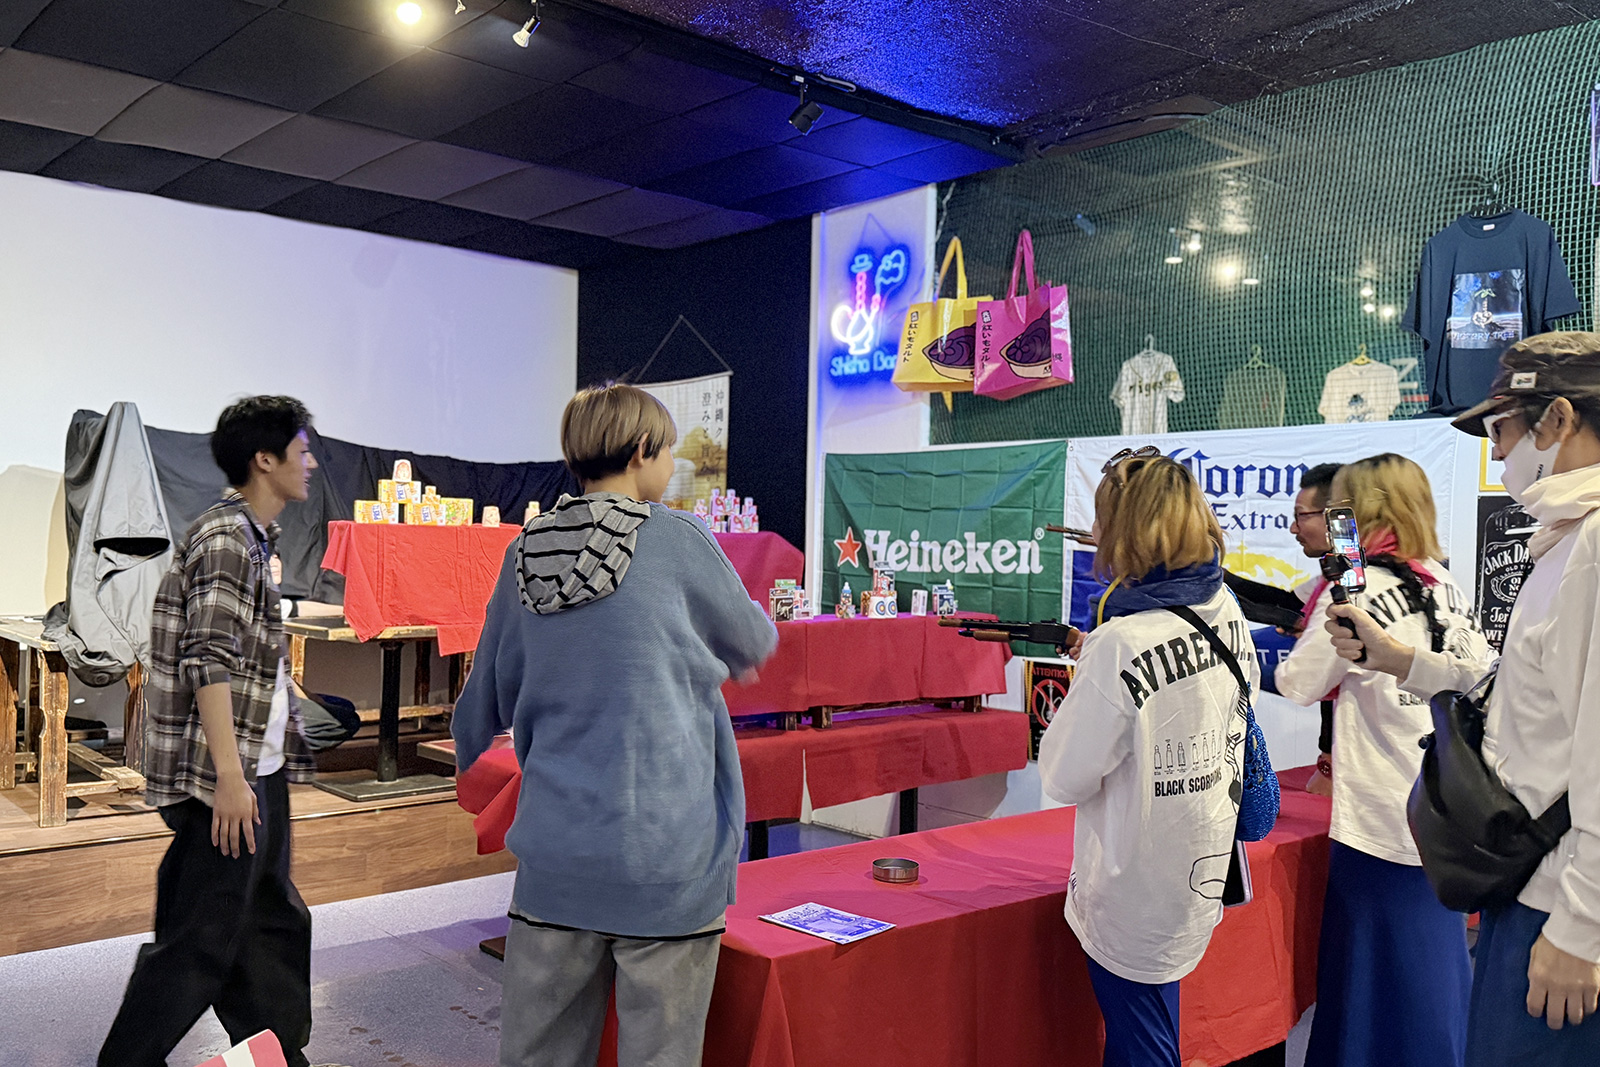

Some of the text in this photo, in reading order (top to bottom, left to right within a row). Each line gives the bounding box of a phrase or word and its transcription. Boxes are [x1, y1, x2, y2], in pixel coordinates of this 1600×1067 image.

[981, 324, 993, 369] 紅いもタルト
[1167, 447, 1310, 499] Coron
[1211, 503, 1289, 531] Extra
[1485, 549, 1513, 576] JACK
[1155, 779, 1185, 797] BLACK
